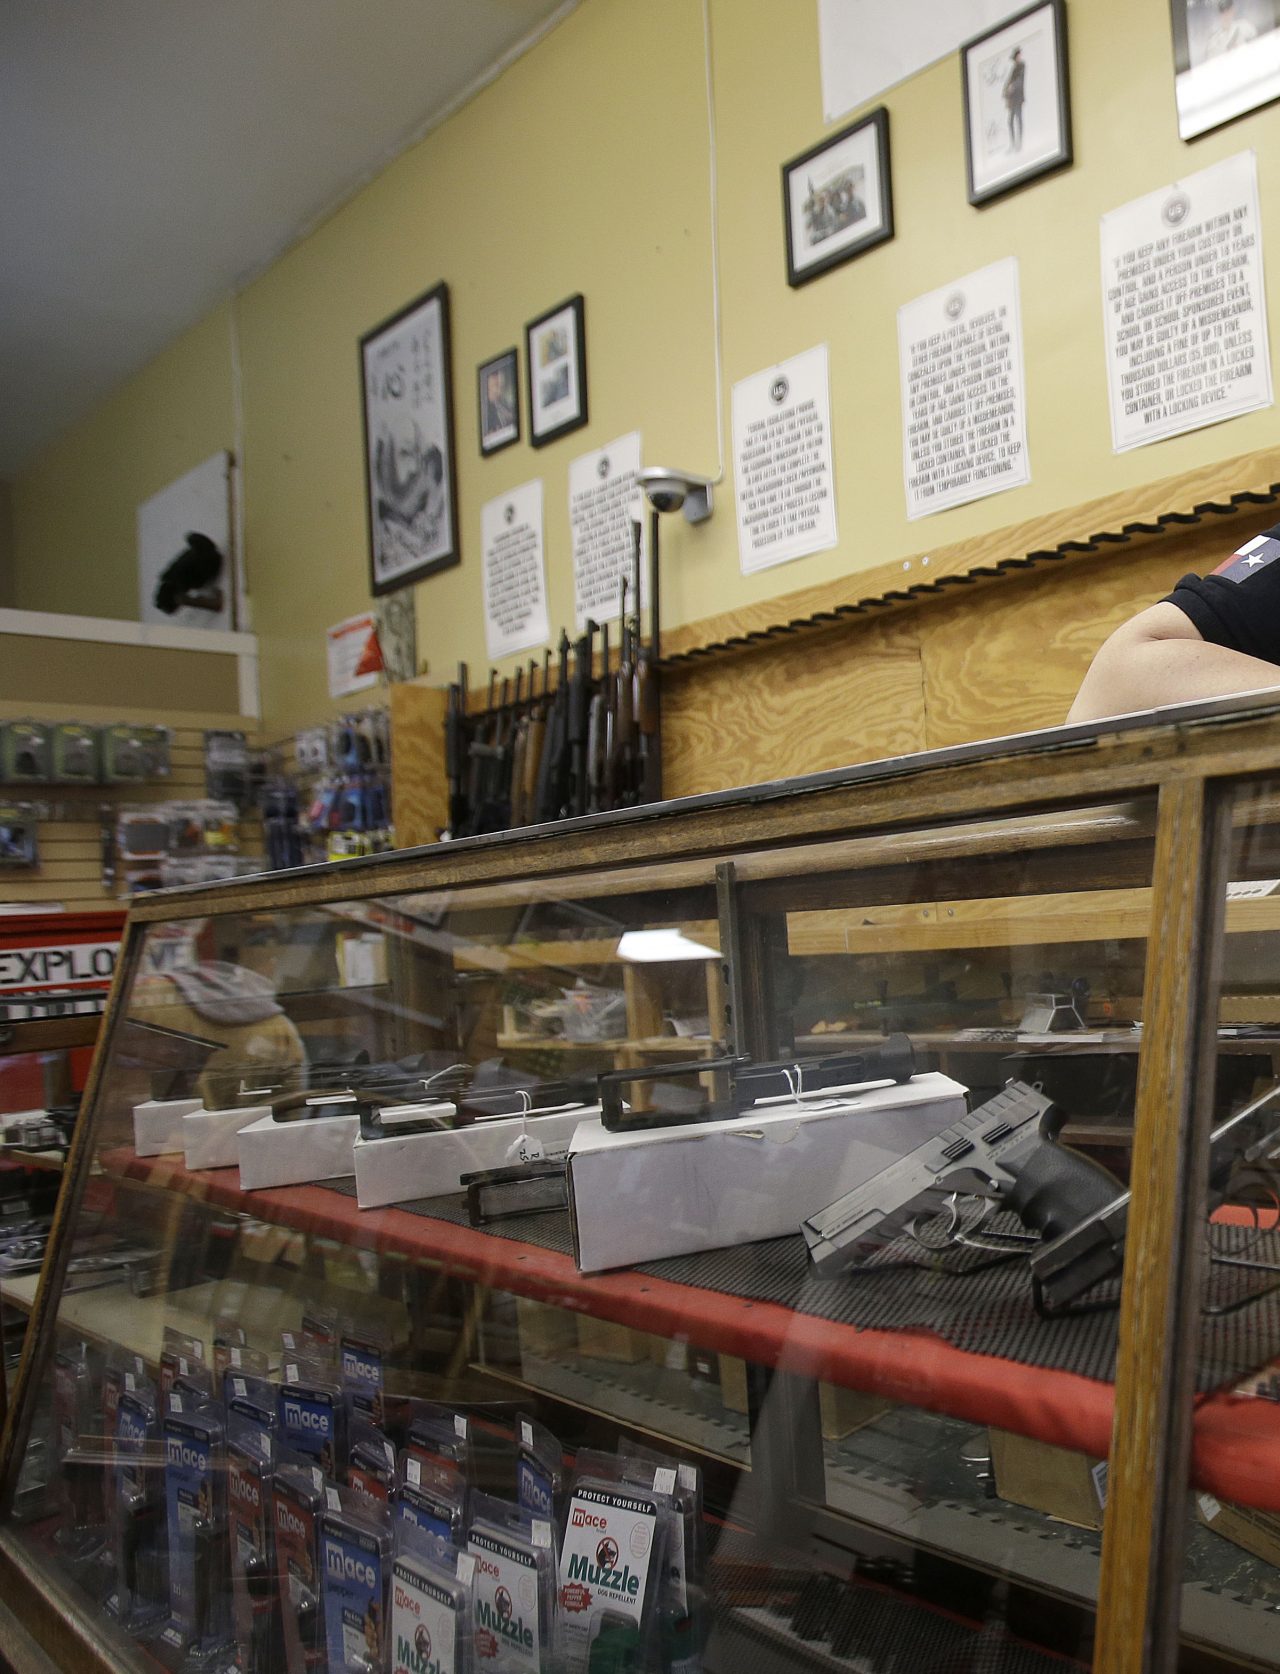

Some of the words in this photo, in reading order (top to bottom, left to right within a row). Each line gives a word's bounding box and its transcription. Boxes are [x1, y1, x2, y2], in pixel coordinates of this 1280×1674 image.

[0, 948, 117, 984] EXPLO
[344, 1352, 379, 1380] mace
[285, 1402, 329, 1431] mace
[167, 1437, 206, 1471] mace
[229, 1464, 259, 1506] mace
[522, 1467, 550, 1512] mac
[578, 1490, 610, 1504] PROTECT
[612, 1496, 652, 1514] YOURSELF
[277, 1501, 306, 1538] mace
[572, 1508, 607, 1528] mace
[326, 1540, 376, 1588] mace
[472, 1535, 498, 1551] PROTECT
[500, 1547, 532, 1567] YOURSELF
[396, 1566, 420, 1587] PROTECT
[421, 1582, 451, 1605] YOURSELF
[568, 1553, 640, 1595] Muzzle
[608, 1592, 637, 1605] REPELLENT
[477, 1599, 533, 1648] Muzzle
